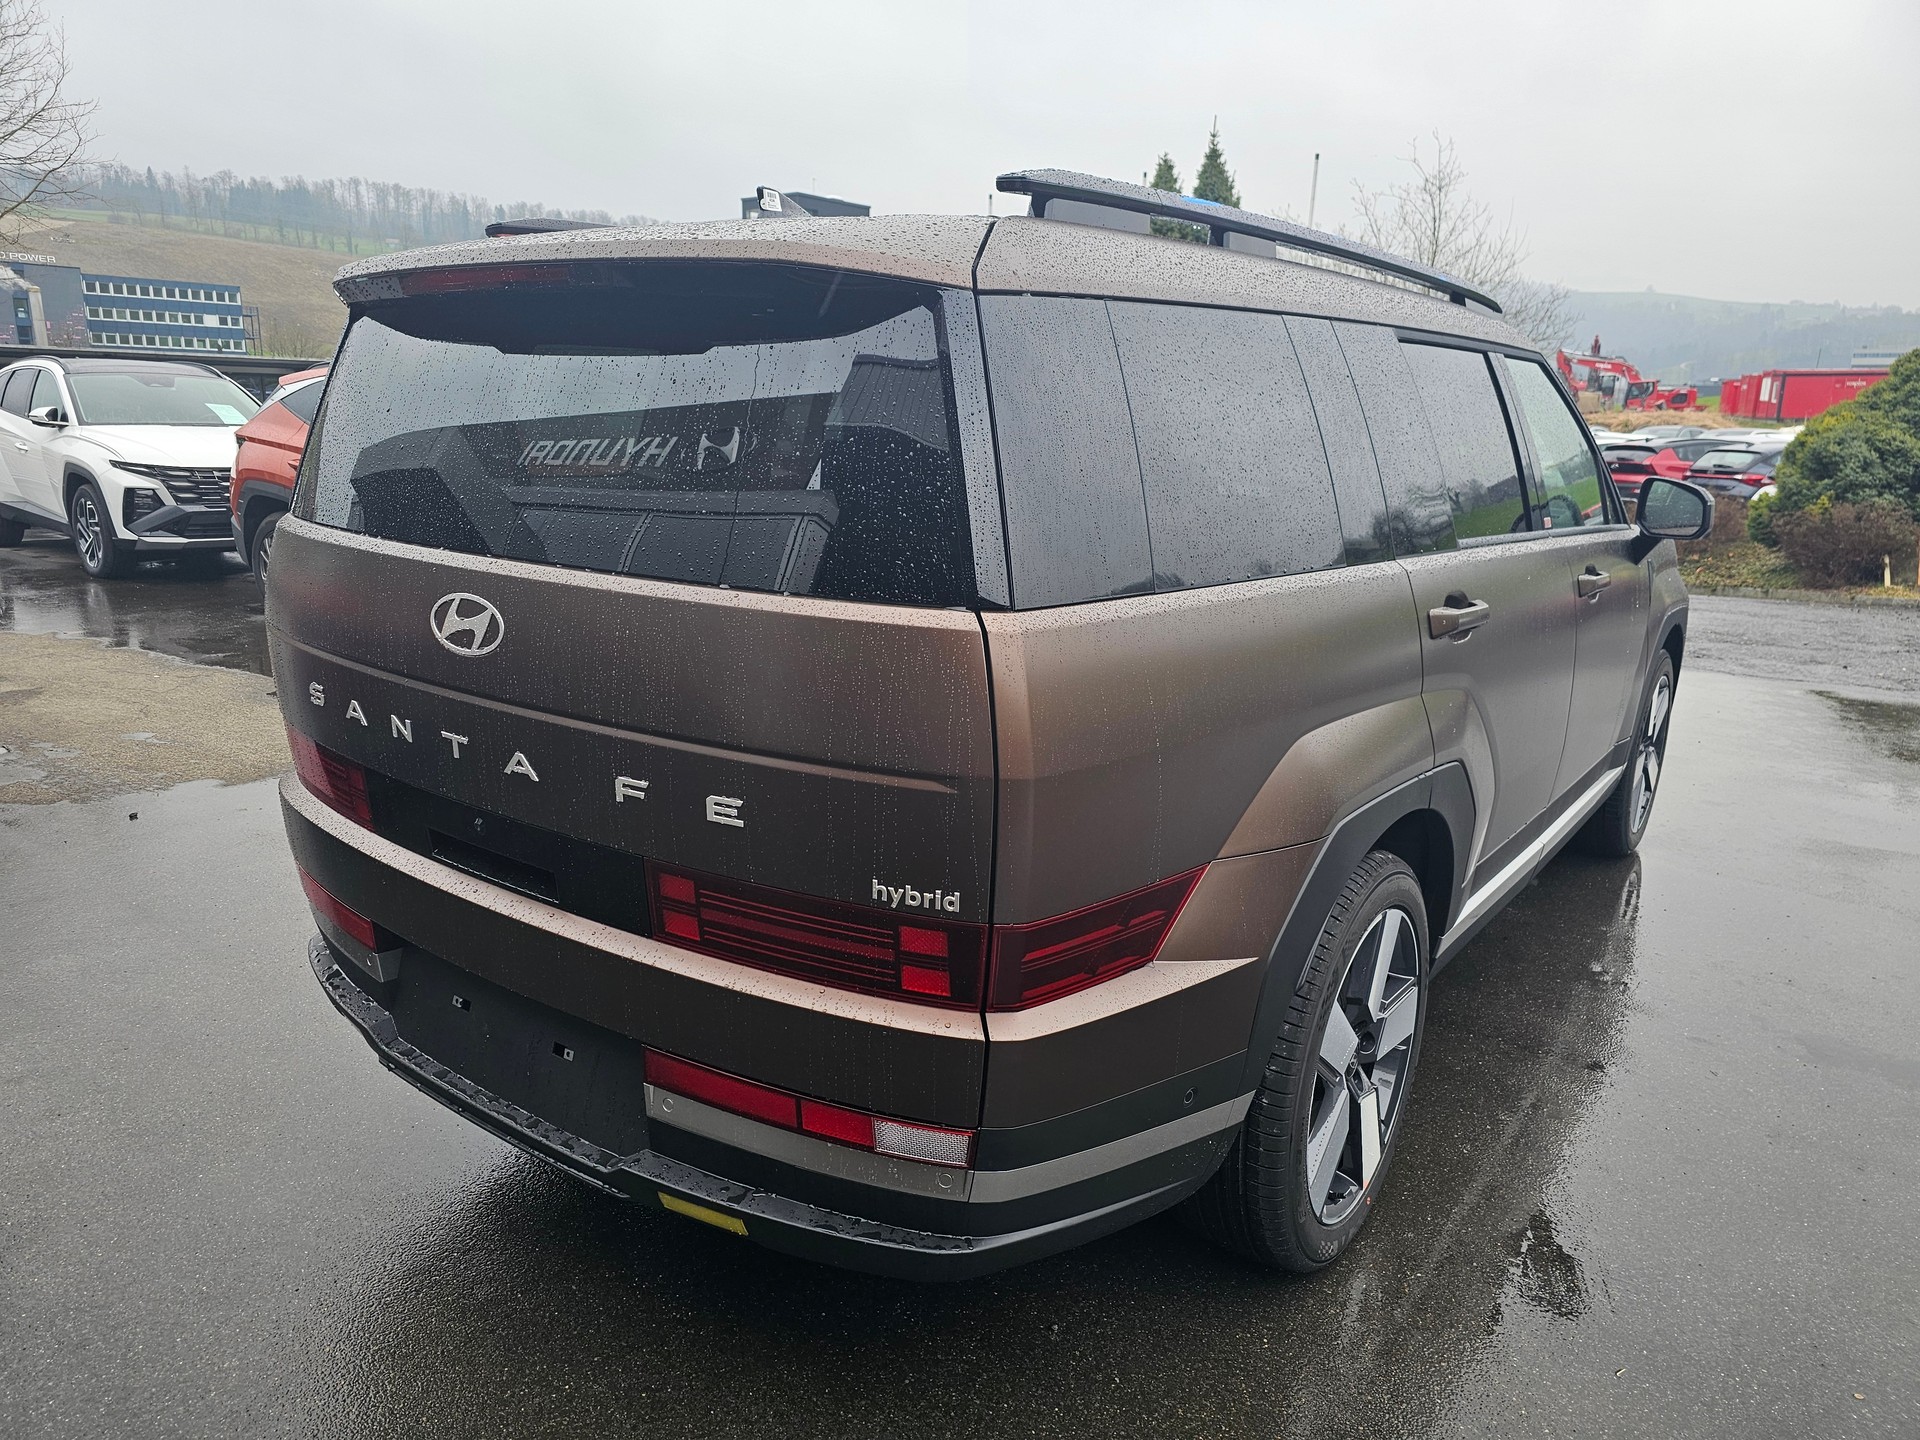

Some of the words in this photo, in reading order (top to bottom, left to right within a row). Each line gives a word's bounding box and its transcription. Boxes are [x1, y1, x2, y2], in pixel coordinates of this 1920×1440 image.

[9, 252, 56, 262] POWER
[308, 681, 539, 782] SANTA
[615, 776, 745, 827] FE
[871, 879, 960, 913] hybrid
